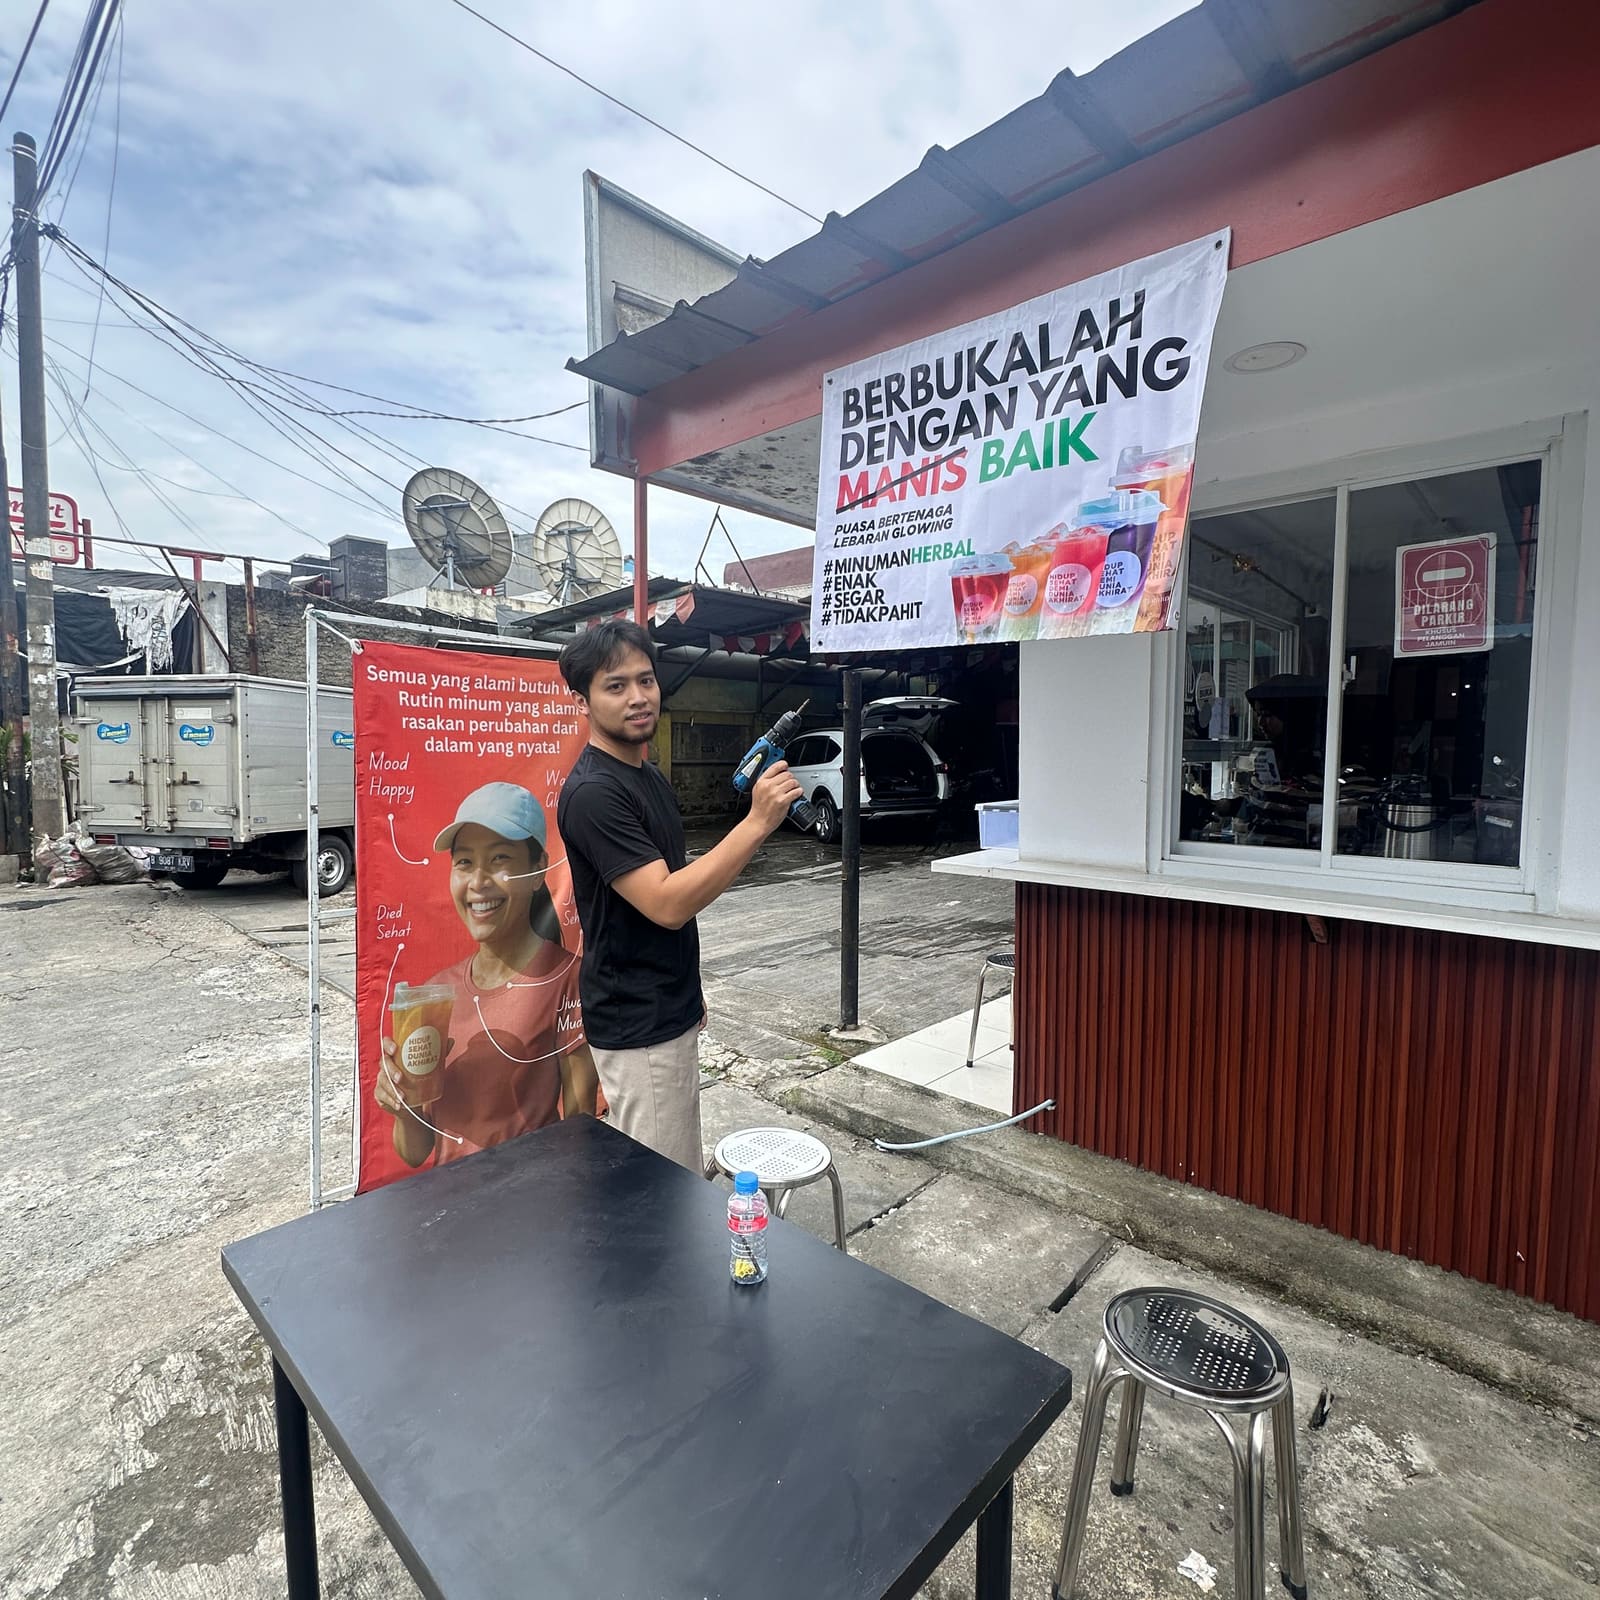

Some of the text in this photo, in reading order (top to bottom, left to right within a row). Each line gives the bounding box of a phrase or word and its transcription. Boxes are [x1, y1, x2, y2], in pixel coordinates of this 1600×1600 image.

[841, 289, 1146, 429] BERBUKALAH
[839, 336, 1191, 471] DENGAN YANG
[836, 412, 1099, 515] MANIS BAIK
[834, 504, 953, 535] PUASA BERTENAGA
[834, 518, 953, 548] LEBARAN GLOWING
[1101, 568, 1125, 577] EHAT
[1104, 562, 1123, 570] DUP
[1100, 582, 1122, 590] UNIA
[1414, 599, 1473, 616] DILARANG
[1421, 612, 1465, 627] PARKIR
[367, 664, 427, 686] Semua
[430, 673, 471, 693] yang
[474, 674, 516, 692] alami
[519, 678, 560, 696] butuh
[398, 690, 444, 709] Rutin
[448, 694, 502, 712] minum
[505, 700, 540, 718] yang
[402, 714, 579, 736] rasakan perubahan dari
[424, 736, 561, 758] dalam yang nyata!
[369, 751, 410, 771] Mood
[369, 776, 415, 804] Happy
[376, 902, 403, 921] Died
[376, 921, 412, 940] Sehat
